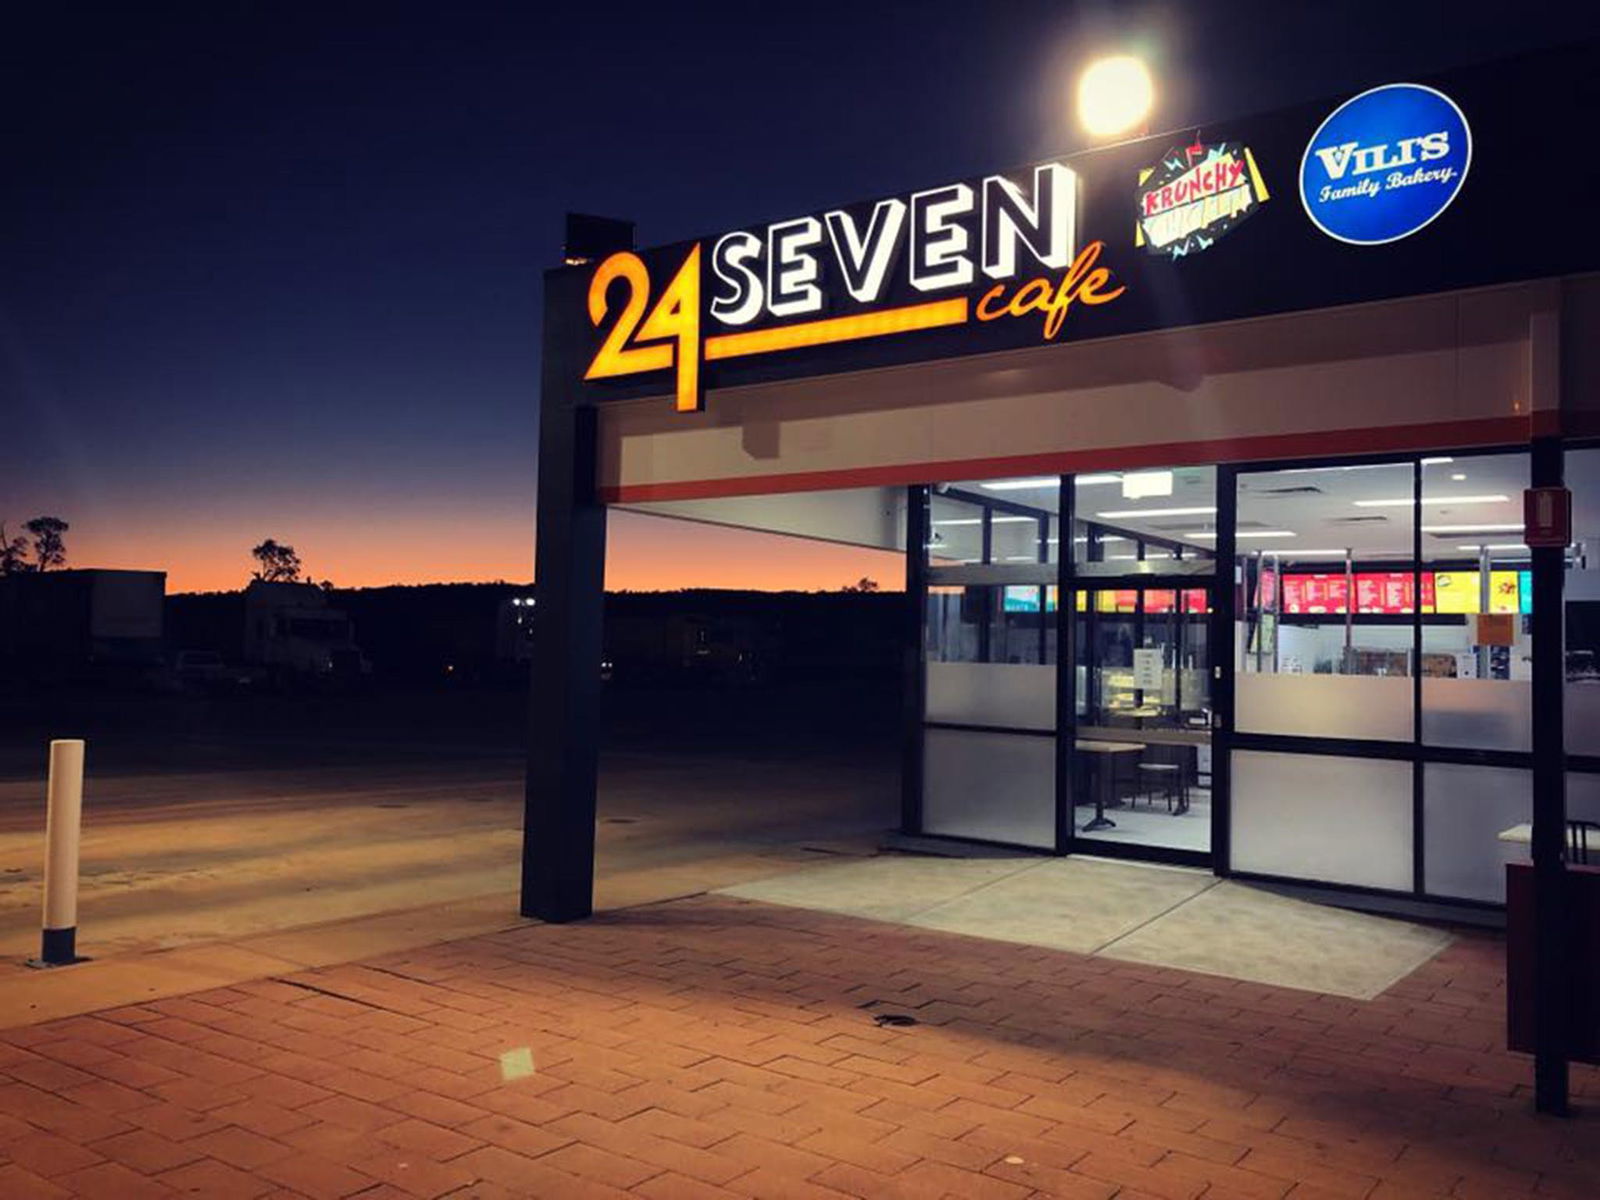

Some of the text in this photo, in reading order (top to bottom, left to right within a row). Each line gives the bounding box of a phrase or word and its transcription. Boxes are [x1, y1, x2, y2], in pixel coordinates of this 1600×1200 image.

[1315, 131, 1450, 180] VILI'S
[1145, 159, 1245, 216] KRUNCHY
[1319, 178, 1381, 202] Family
[584, 162, 1078, 412] 24 SEVEN
[976, 240, 1126, 340] cafe
